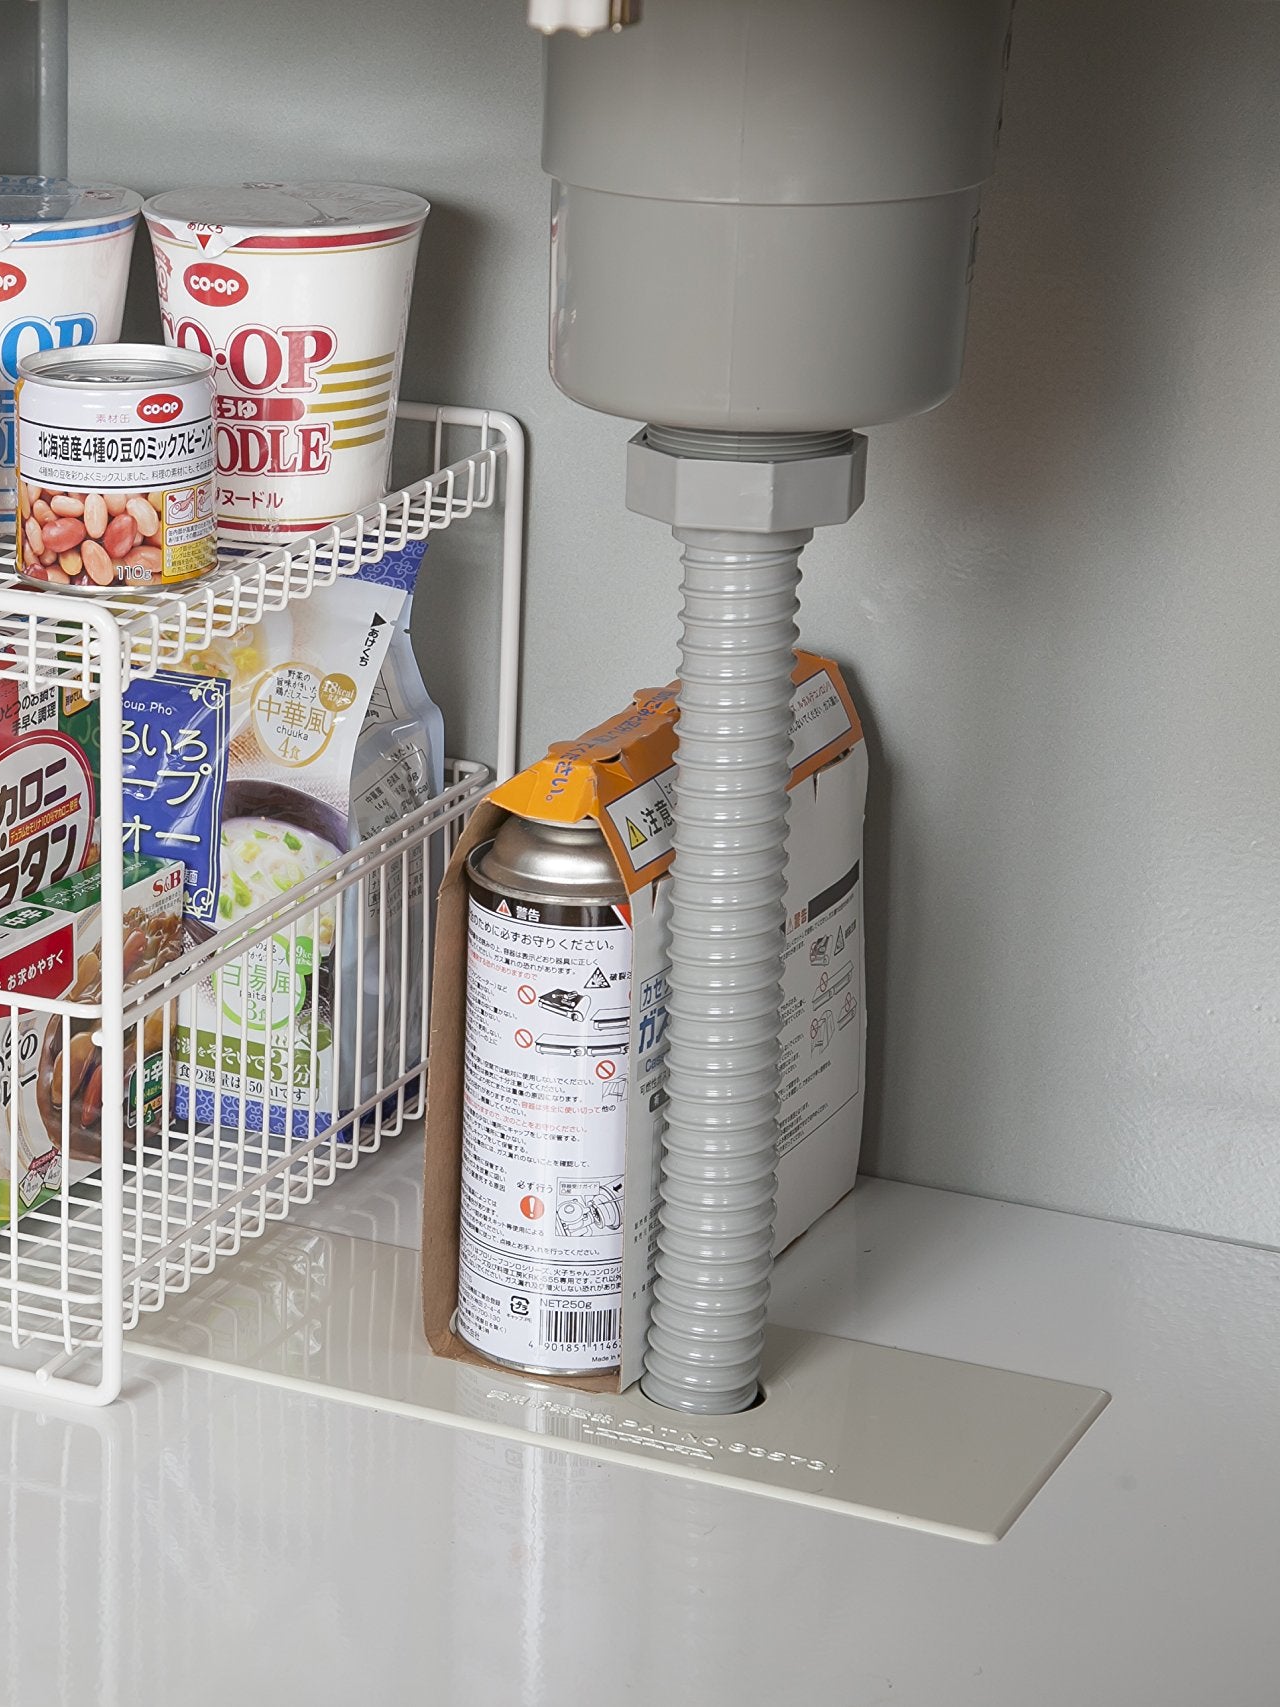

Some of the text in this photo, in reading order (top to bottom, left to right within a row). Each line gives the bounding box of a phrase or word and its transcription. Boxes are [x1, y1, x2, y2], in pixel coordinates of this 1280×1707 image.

[116, 564, 152, 580] 110g
[359, 628, 380, 667] あけくち
[287, 669, 311, 682] 野菜の
[150, 700, 172, 716] Pho
[257, 694, 330, 737] 中華風
[276, 724, 310, 741] chuuka
[152, 869, 182, 898] S&B
[3, 908, 44, 928] 中辛
[515, 905, 541, 922] 警告
[516, 1180, 553, 1194] 必ず行う
[544, 1342, 587, 1352] 901851
